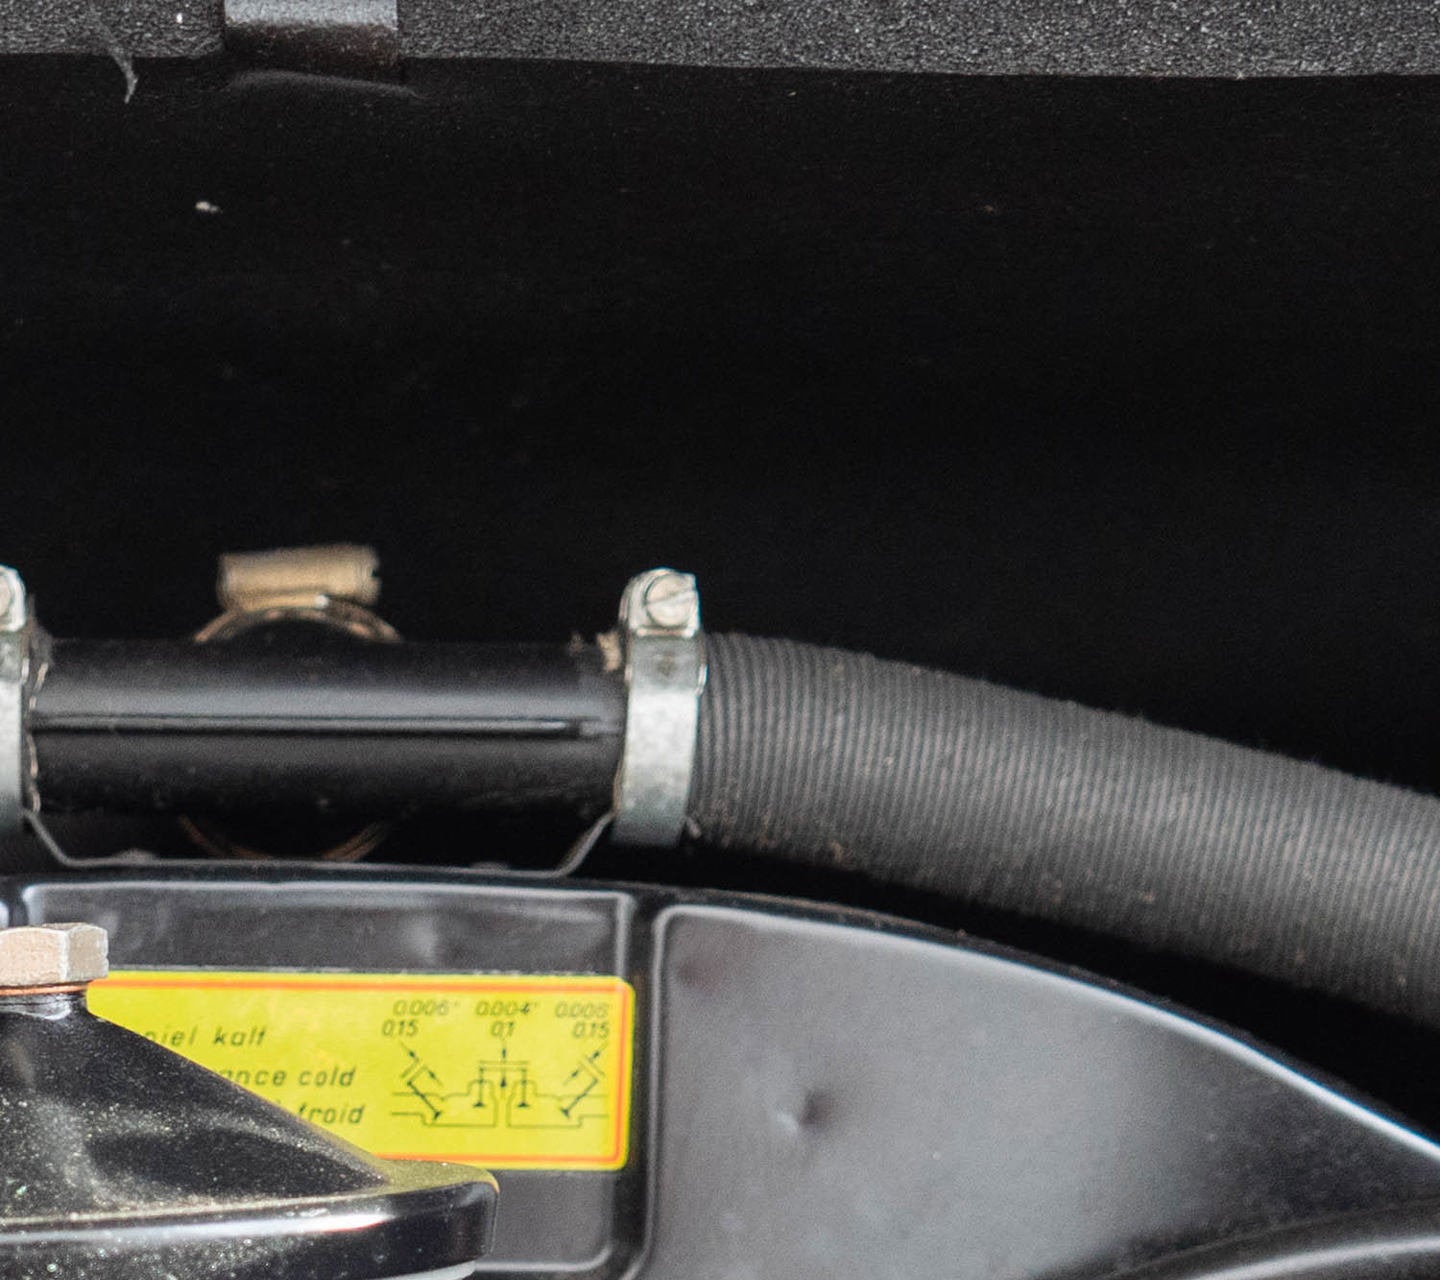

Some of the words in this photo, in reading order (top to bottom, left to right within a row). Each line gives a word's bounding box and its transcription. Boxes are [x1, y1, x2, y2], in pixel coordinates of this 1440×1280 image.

[213, 1025, 267, 1047] kalt
[298, 1066, 356, 1087] cold
[298, 1103, 366, 1125] froid
